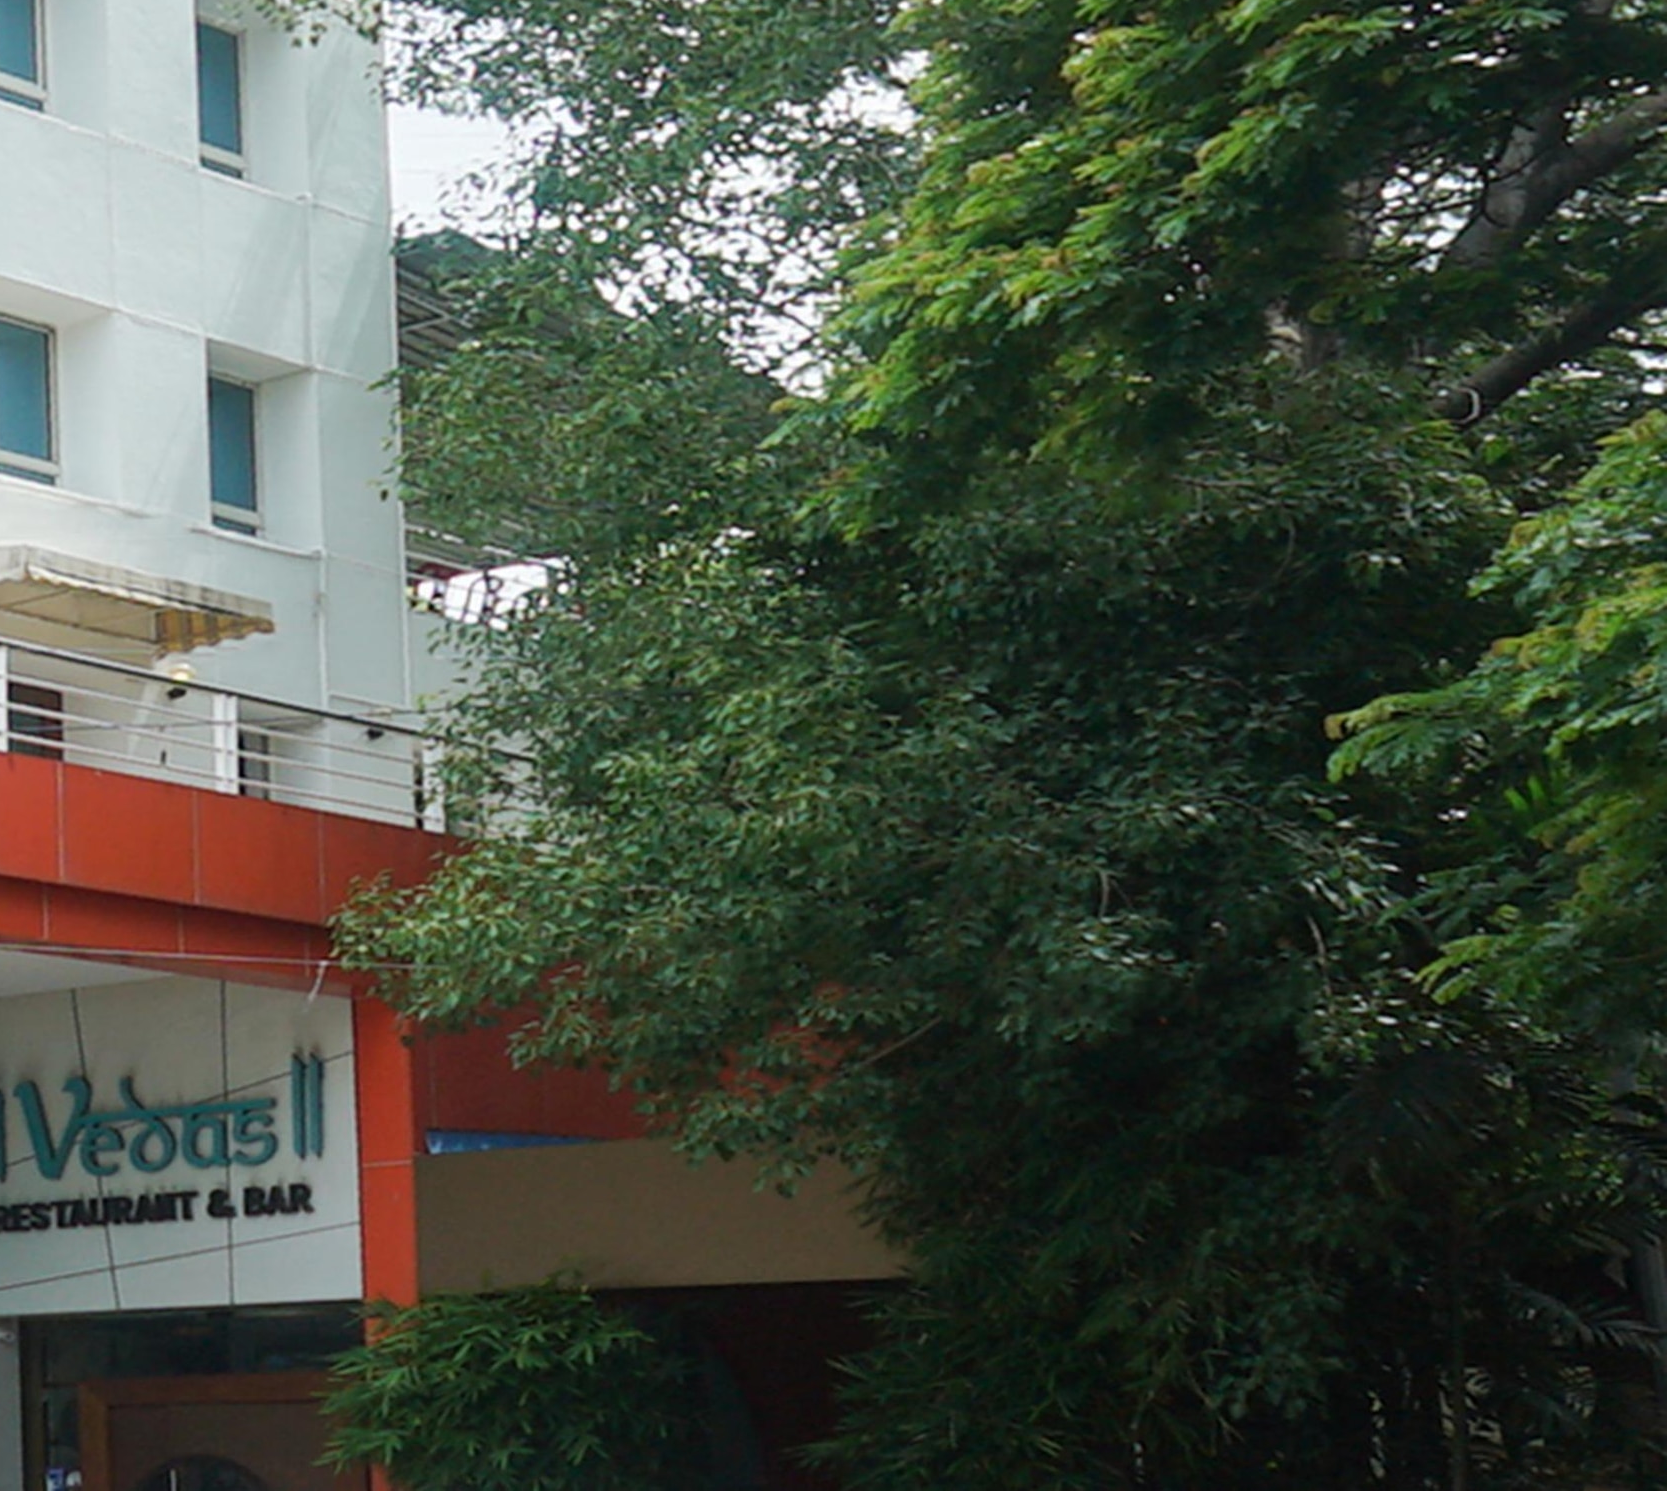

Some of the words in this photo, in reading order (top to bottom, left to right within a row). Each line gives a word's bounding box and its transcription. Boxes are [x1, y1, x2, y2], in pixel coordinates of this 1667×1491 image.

[12, 1074, 279, 1181] Vedas
[206, 1189, 238, 1219] &
[242, 1183, 315, 1216] BAR
